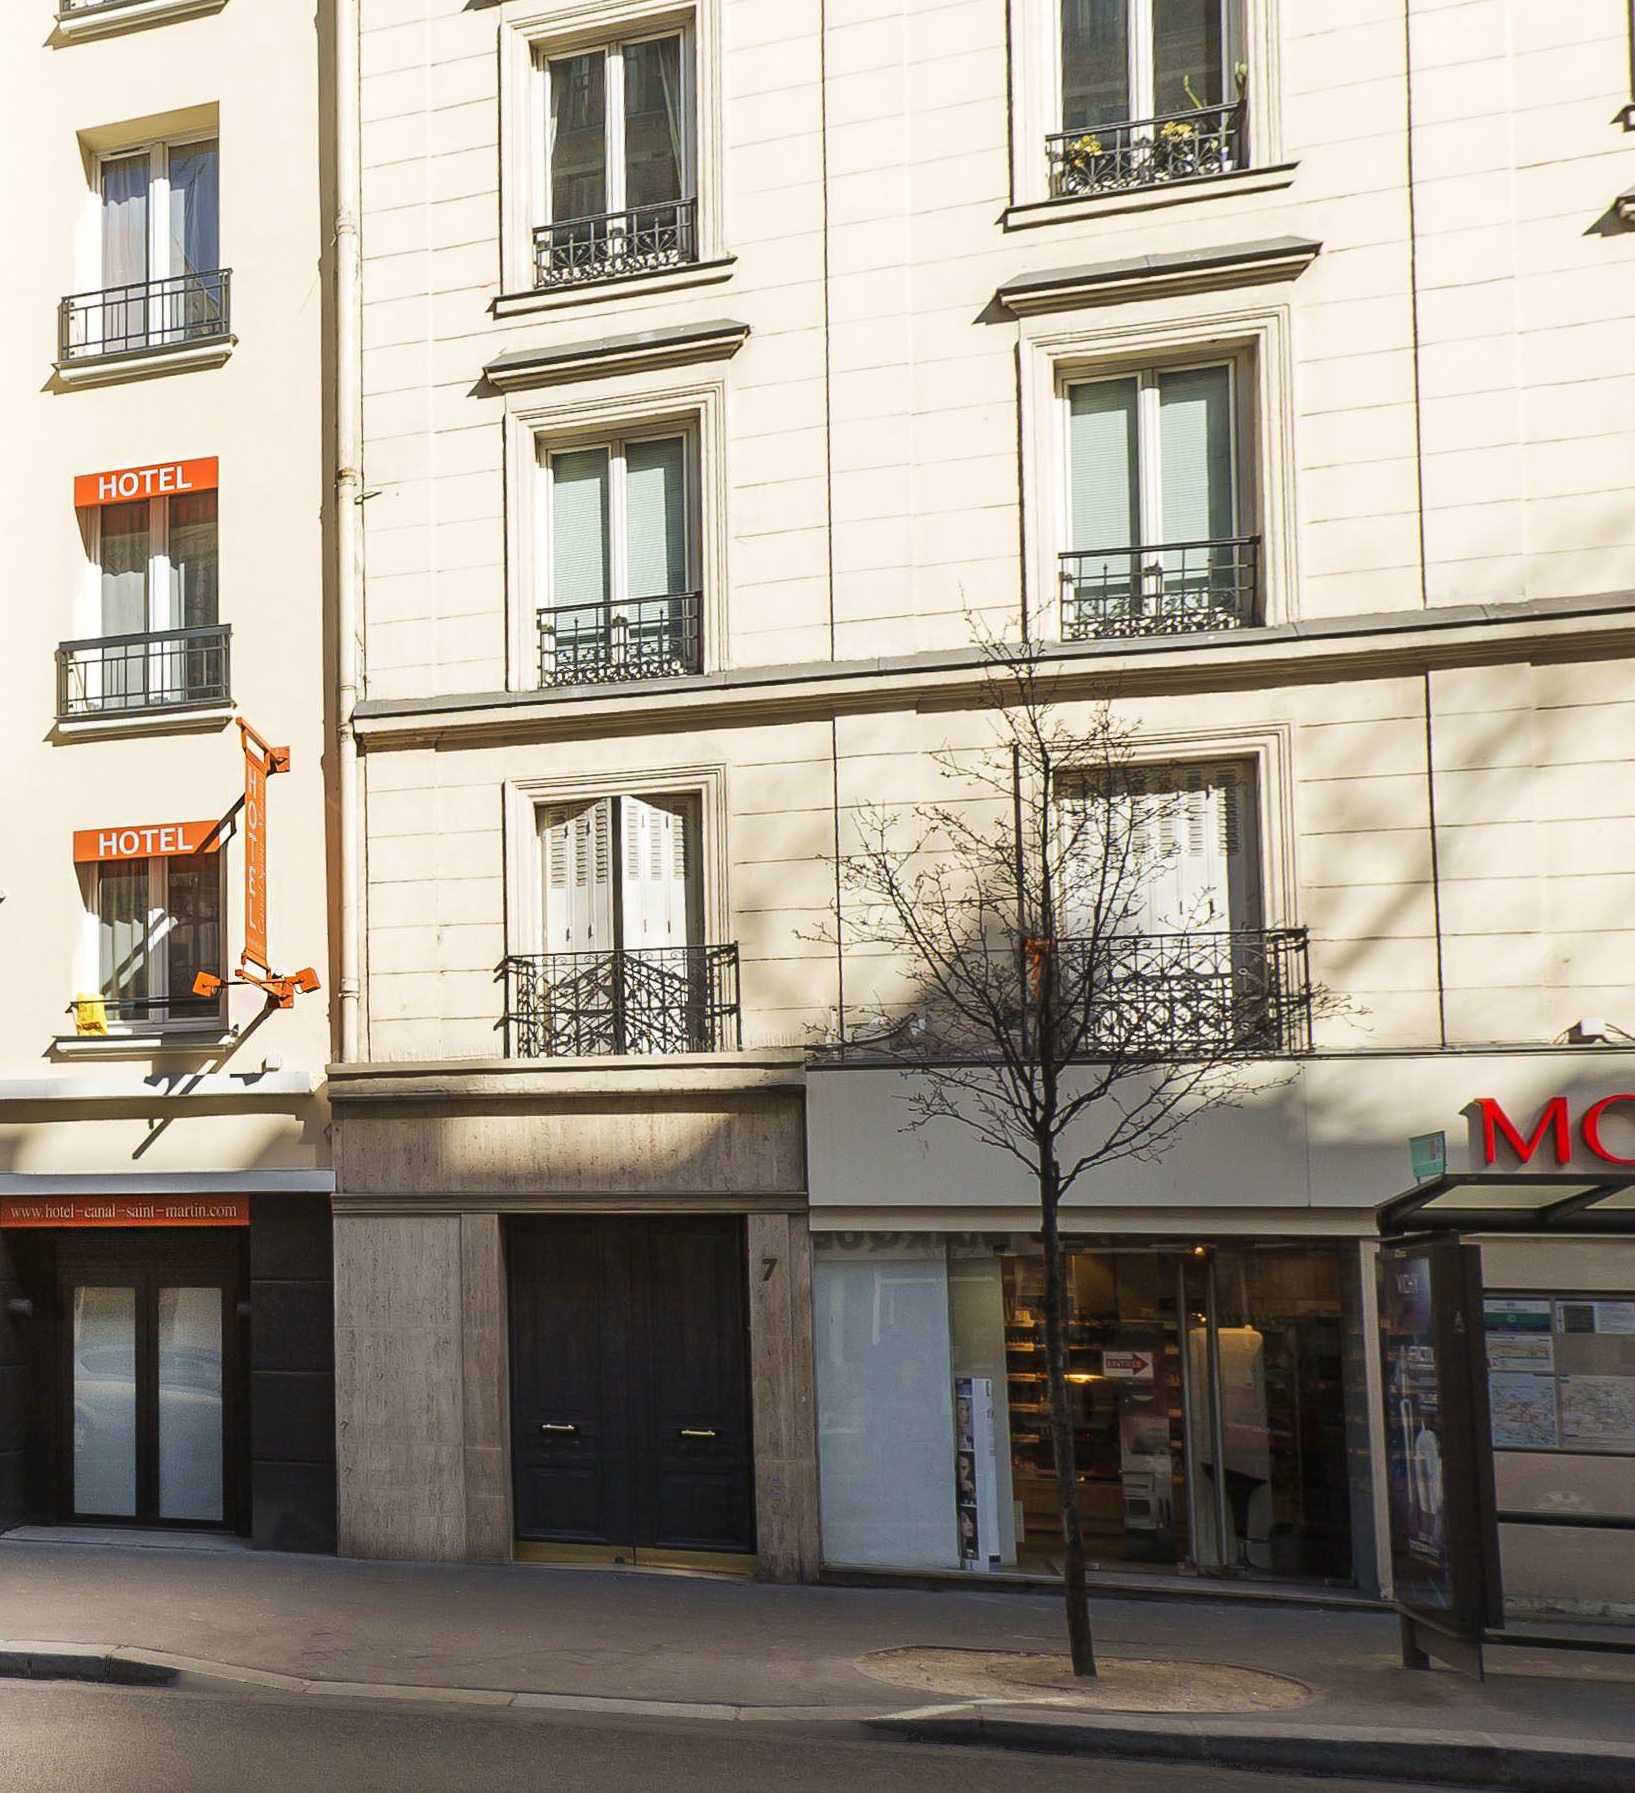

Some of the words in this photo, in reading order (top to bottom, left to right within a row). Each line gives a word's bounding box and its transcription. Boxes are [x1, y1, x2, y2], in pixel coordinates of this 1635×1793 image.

[98, 466, 192, 500] HOTEL
[98, 827, 193, 857] HOTEL
[10, 1203, 237, 1219] www.hotel-canal-saint-martin.com
[761, 1258, 777, 1282] 7
